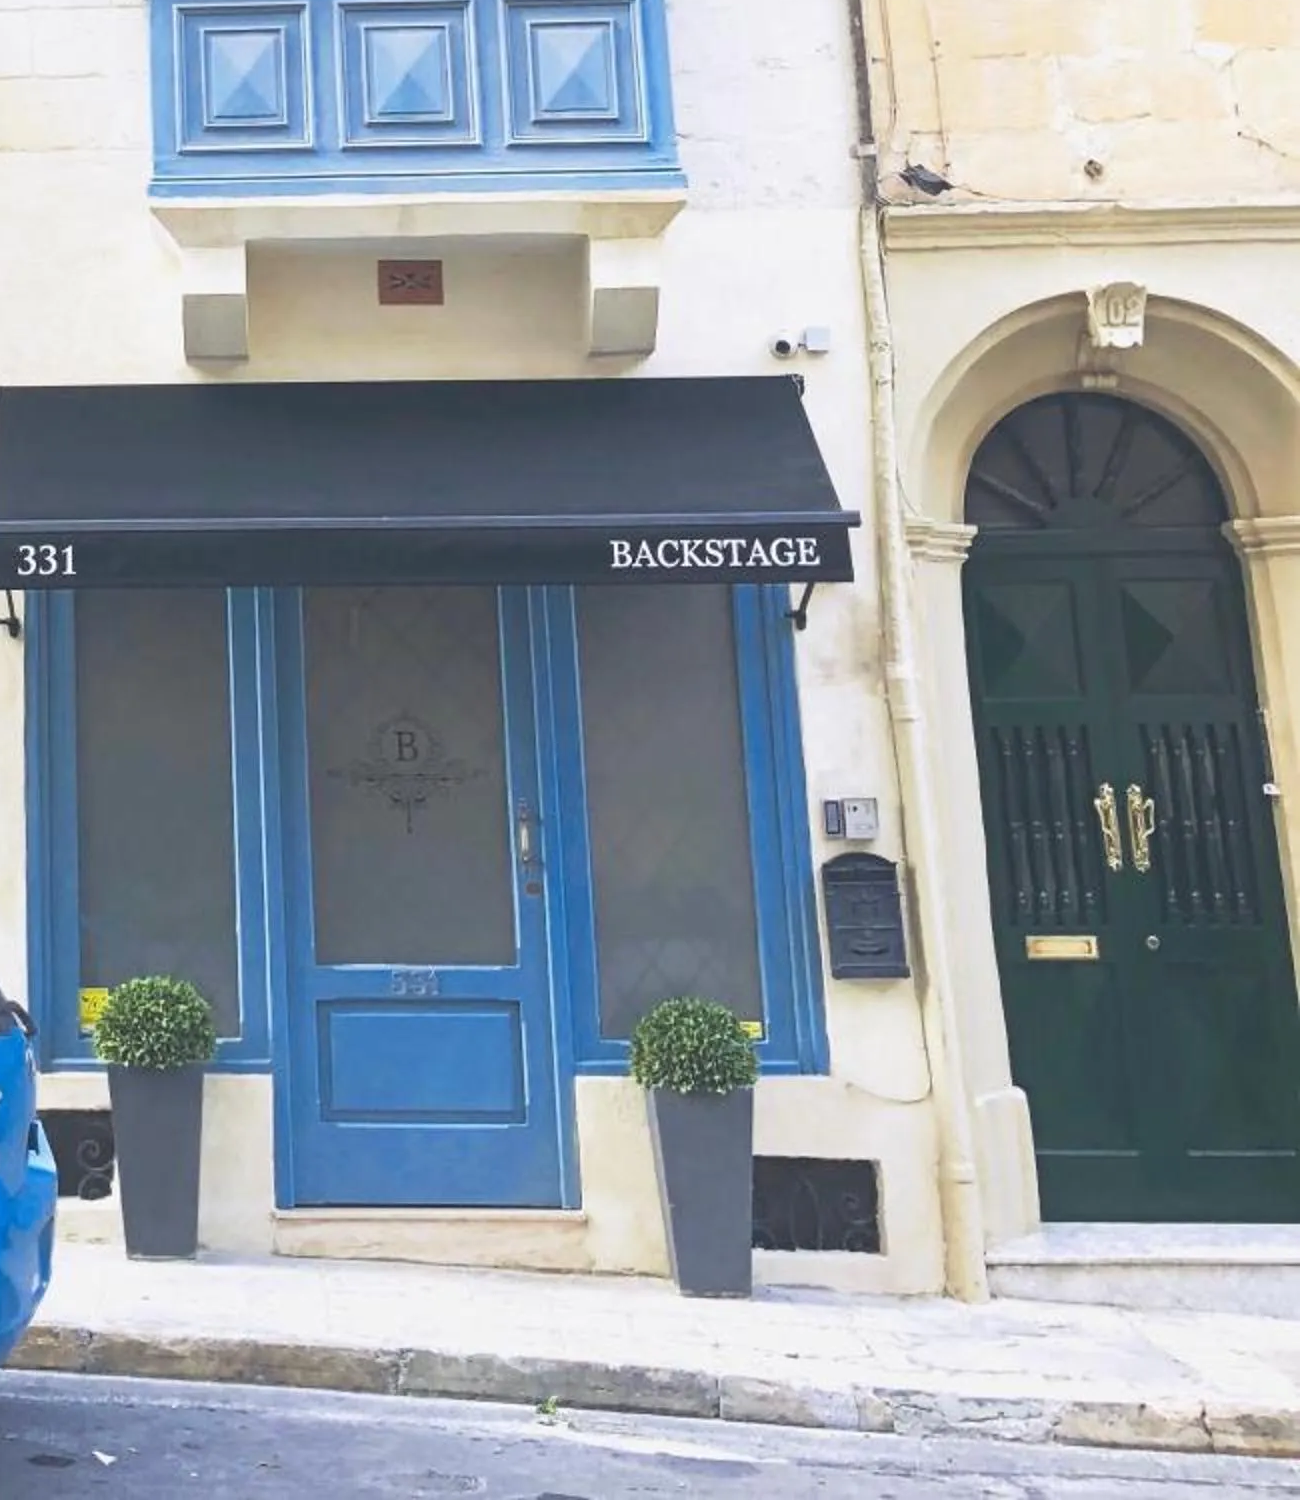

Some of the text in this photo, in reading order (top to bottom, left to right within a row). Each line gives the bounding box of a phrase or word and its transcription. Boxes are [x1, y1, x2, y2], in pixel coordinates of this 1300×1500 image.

[17, 544, 77, 575] 331
[610, 537, 821, 569] BACKSTAGE
[394, 731, 418, 761] B
